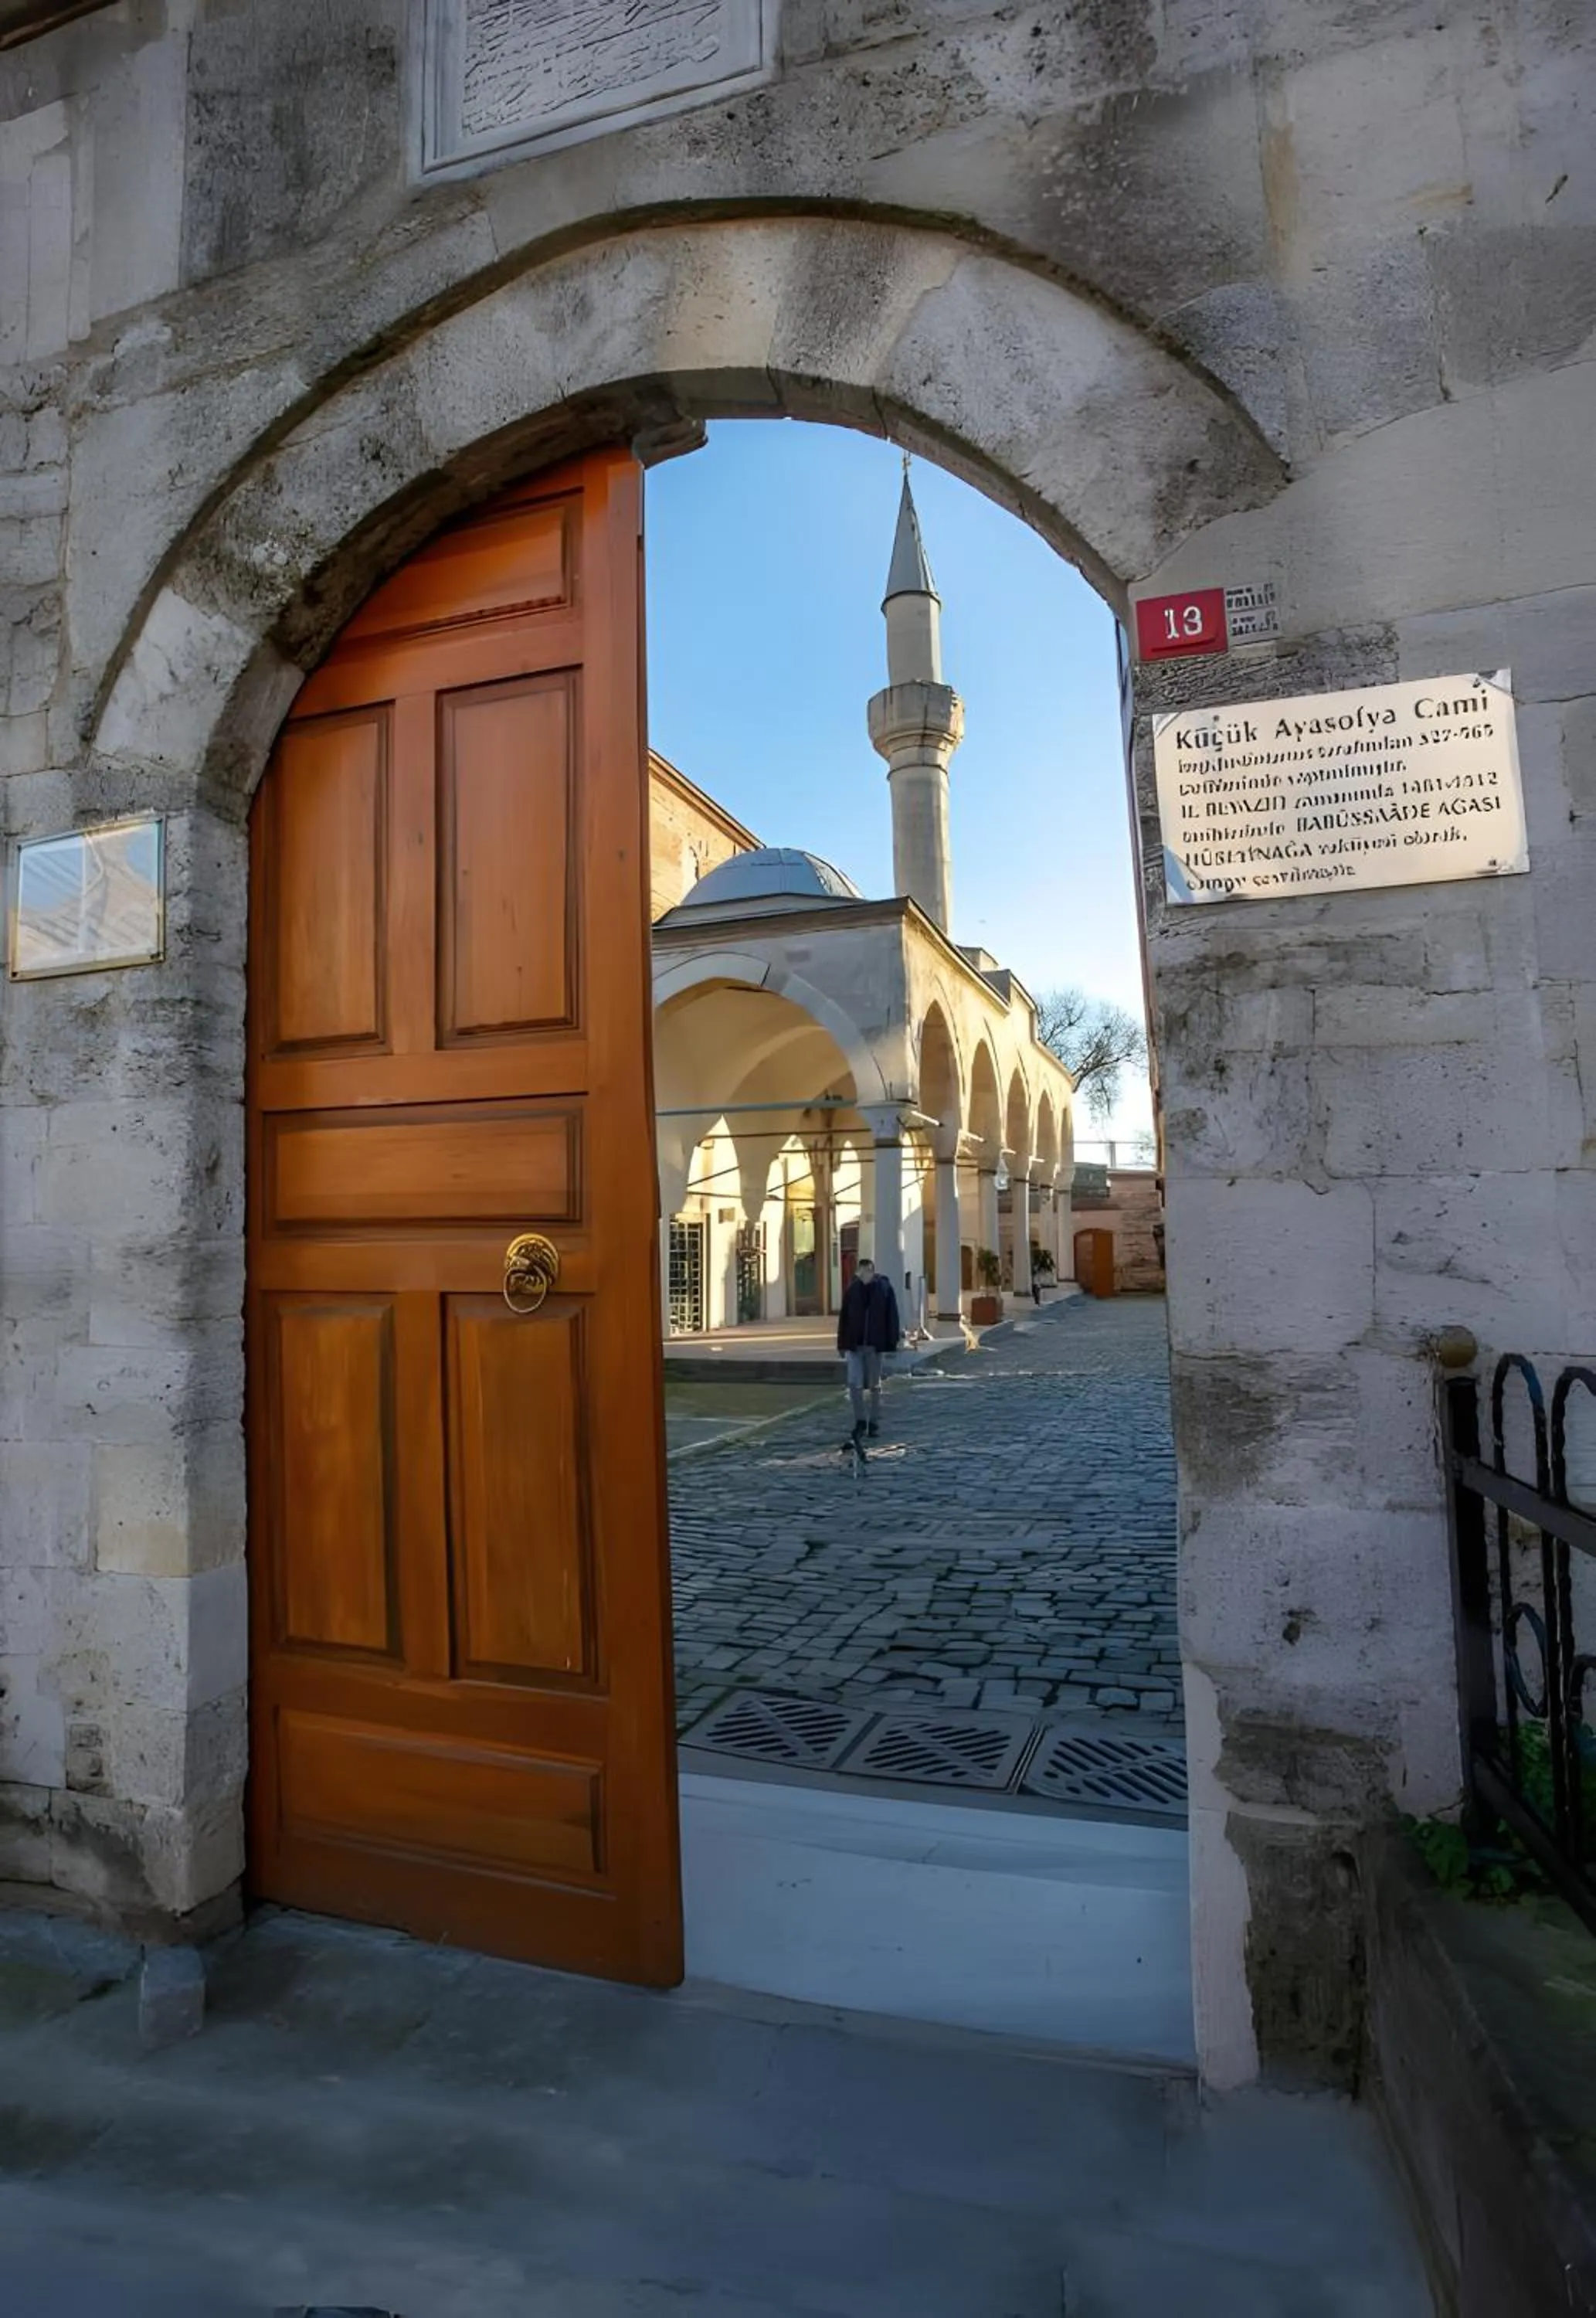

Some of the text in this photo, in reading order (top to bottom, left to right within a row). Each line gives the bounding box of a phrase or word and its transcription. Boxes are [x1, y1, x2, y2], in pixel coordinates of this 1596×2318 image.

[1164, 606, 1202, 639] 13
[1177, 689, 1488, 752] Küçük Ayasofya Cami
